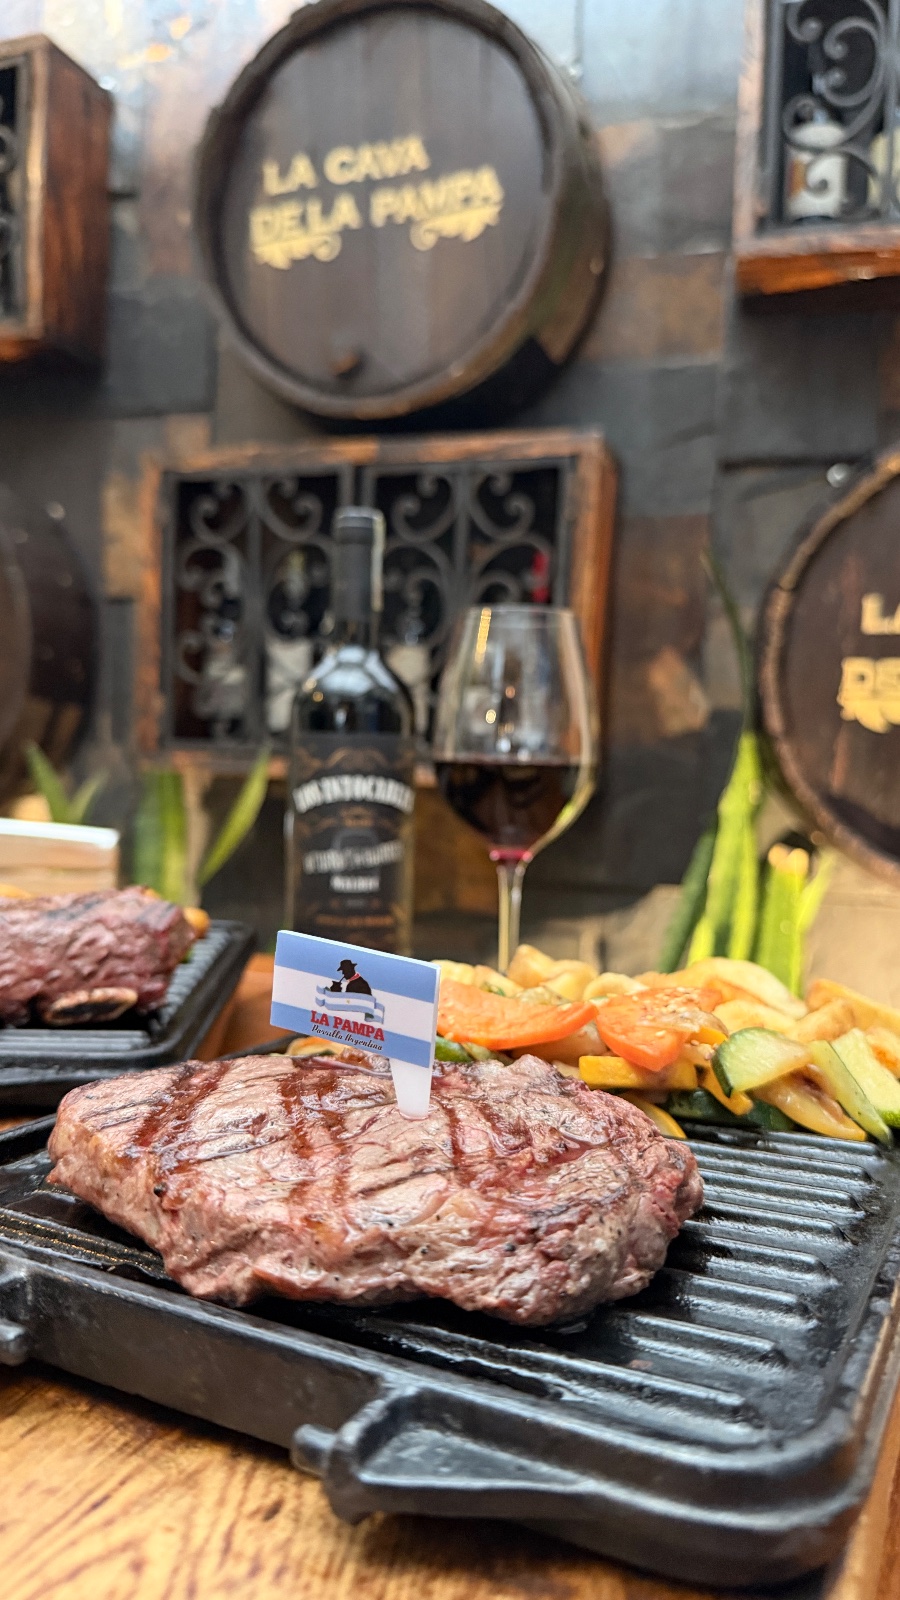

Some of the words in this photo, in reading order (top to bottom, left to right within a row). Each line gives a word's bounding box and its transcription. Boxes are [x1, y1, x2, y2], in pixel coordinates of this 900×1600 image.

[262, 153, 319, 196] LA
[324, 134, 431, 185] CAVA
[369, 164, 505, 228] PAMPA
[861, 592, 900, 635] L
[311, 1010, 330, 1026] LA
[334, 1016, 385, 1041] PAMPA
[311, 1024, 343, 1040] Parrilla
[344, 1035, 383, 1050] Argentina
